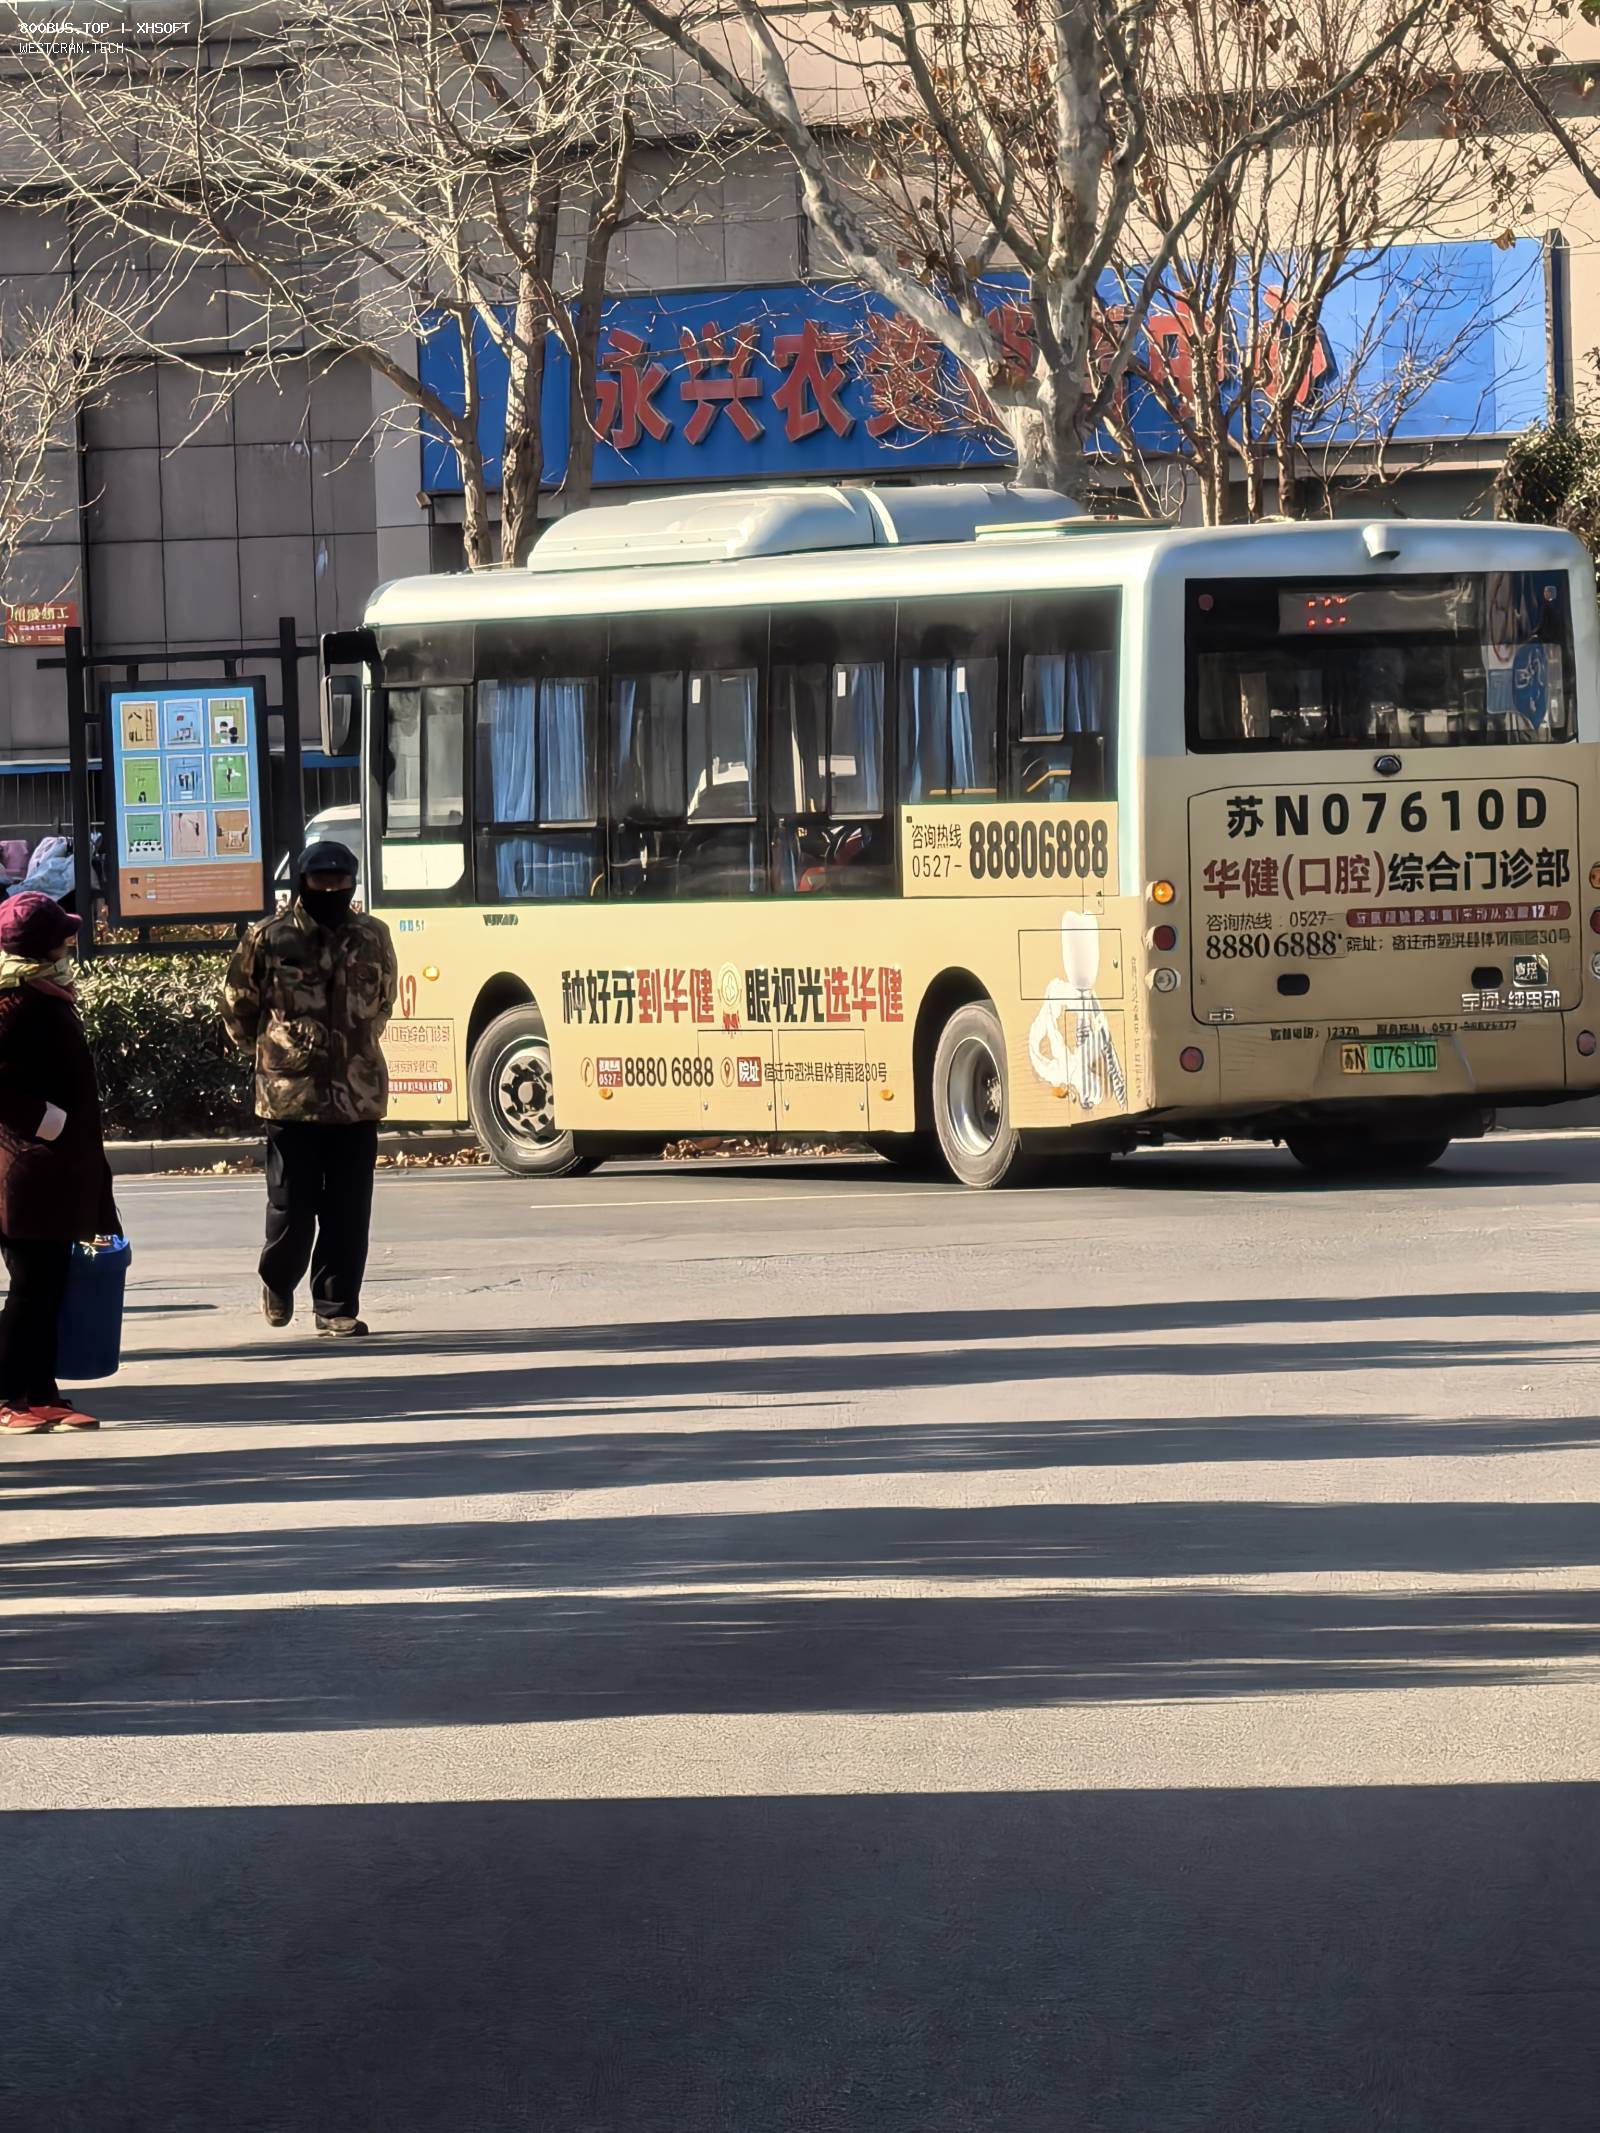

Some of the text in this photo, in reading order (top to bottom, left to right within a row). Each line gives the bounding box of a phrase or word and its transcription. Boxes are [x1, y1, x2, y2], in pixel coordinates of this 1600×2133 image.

[1226, 788, 1547, 838] 苏N07610D
[912, 819, 1109, 879] 咨询热线 88806888
[912, 854, 962, 878] 0527-
[1203, 847, 1571, 900] 华健(口腔)综合门诊部
[561, 966, 904, 1024] 种好牙到华健 眼视光选华健
